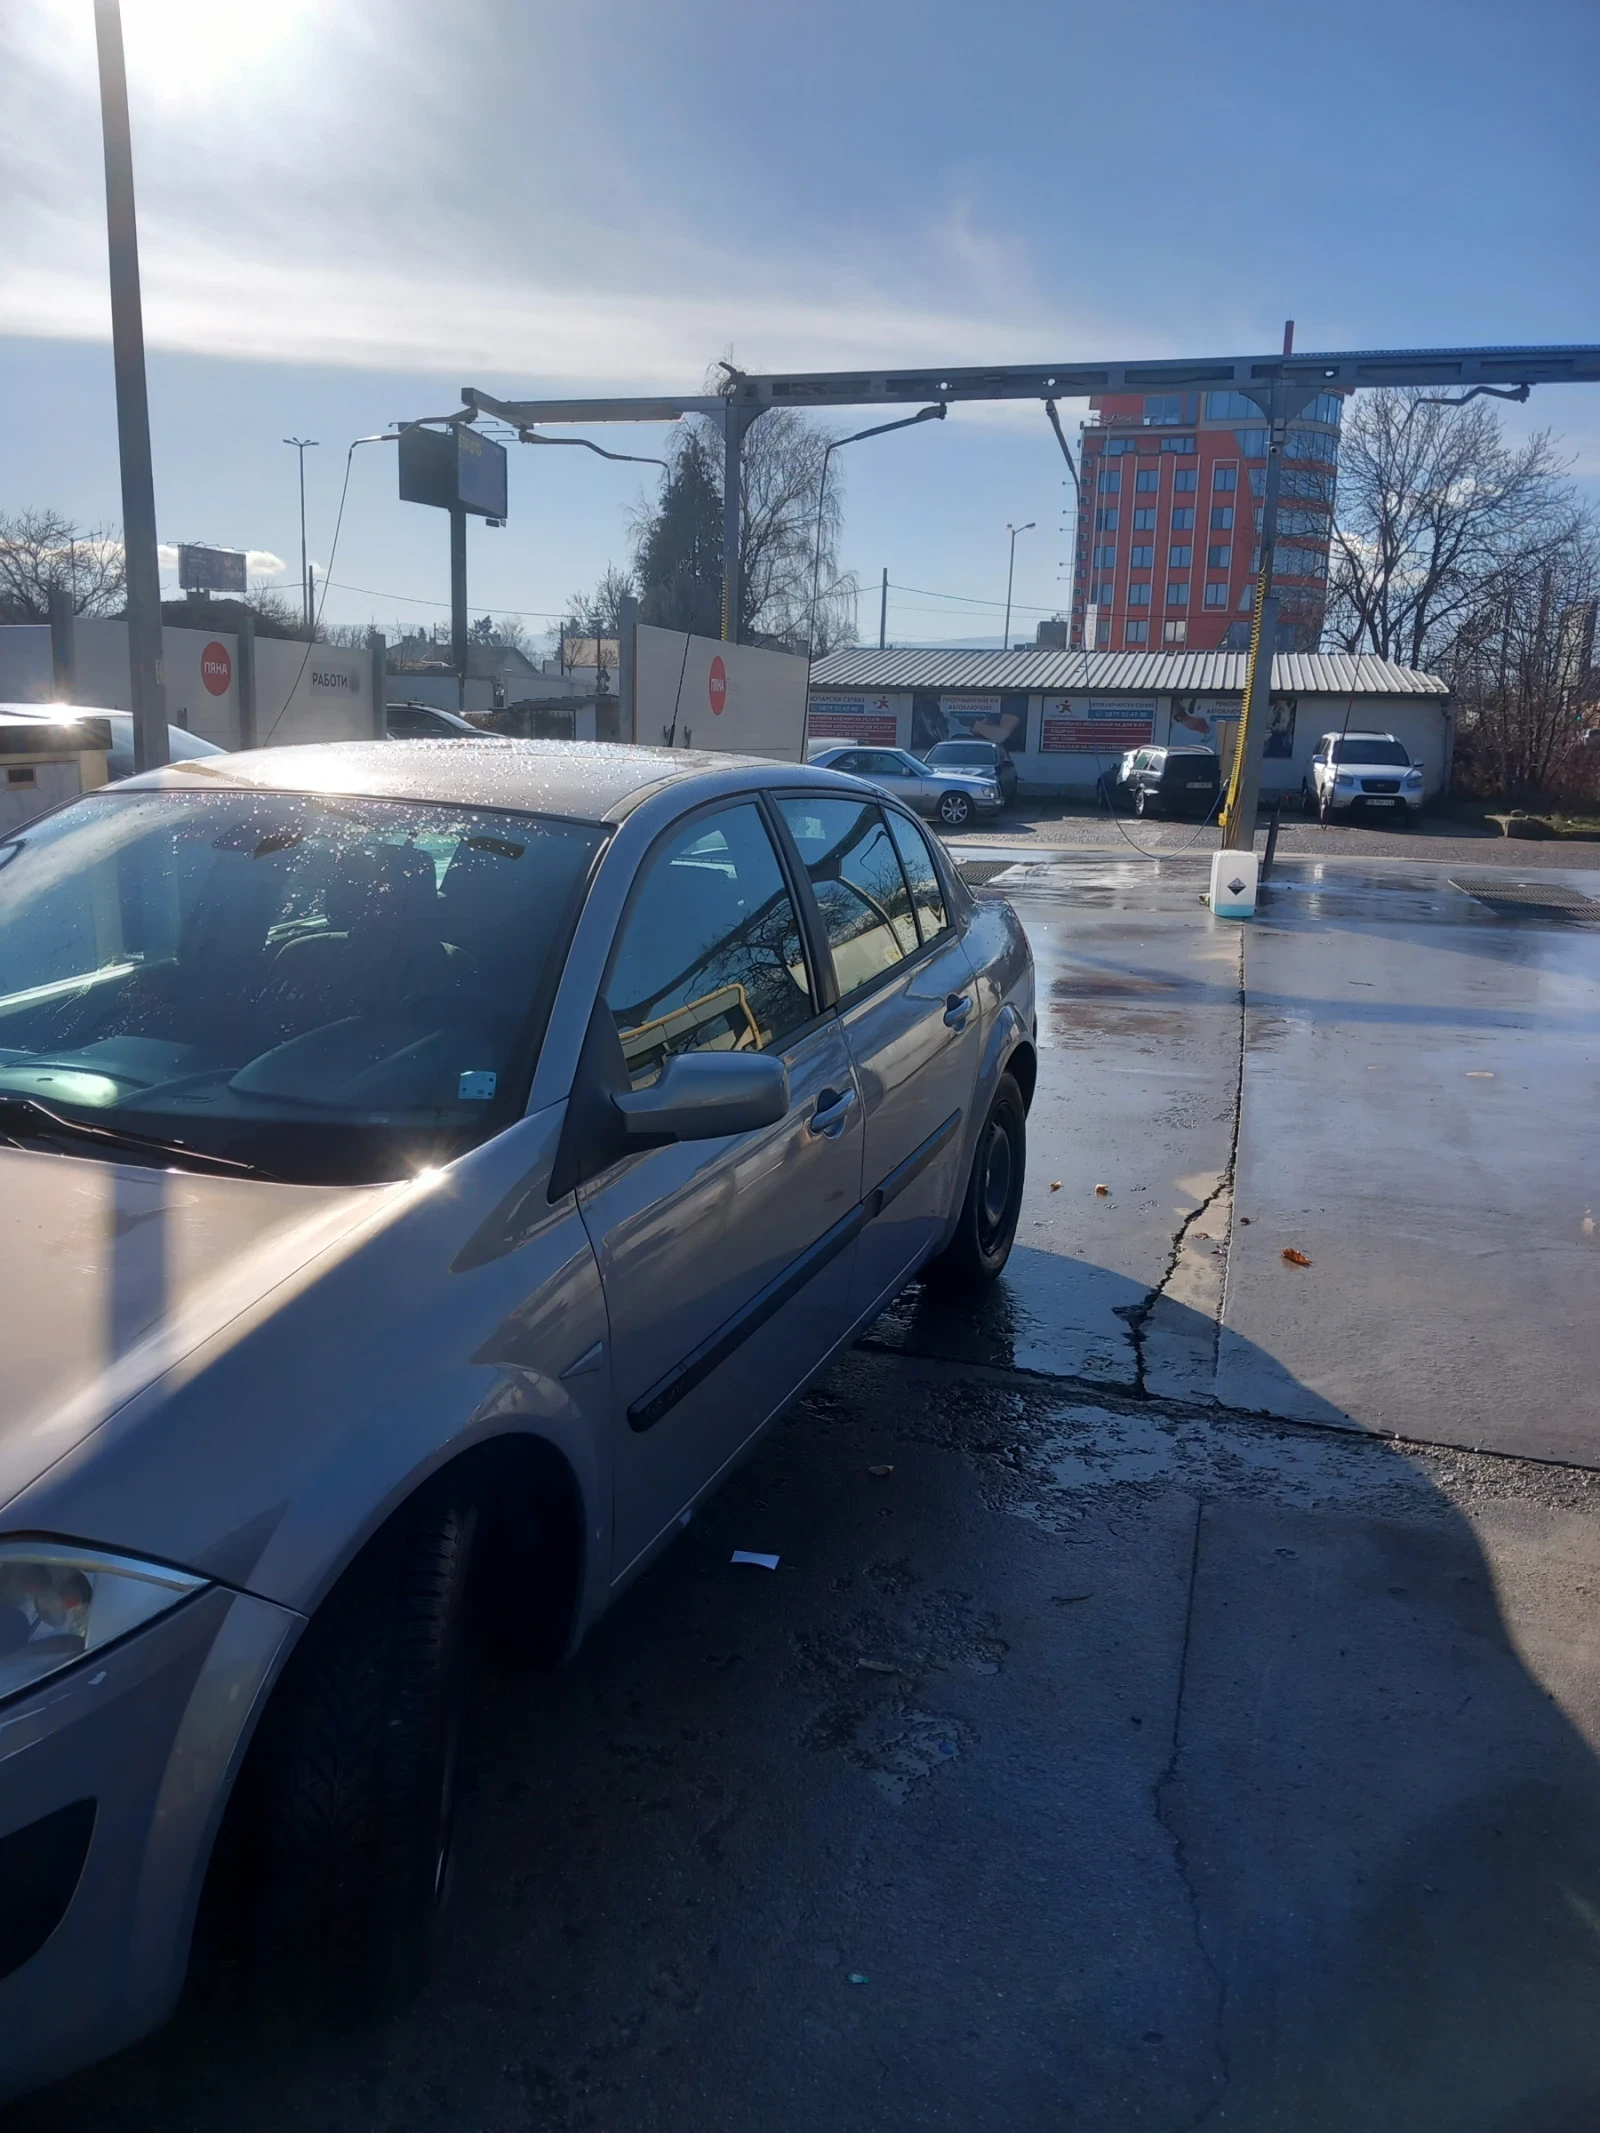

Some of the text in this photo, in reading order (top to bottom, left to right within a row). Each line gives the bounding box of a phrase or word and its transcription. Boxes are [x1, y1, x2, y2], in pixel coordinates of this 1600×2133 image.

[204, 661, 228, 675] ПЯНА
[312, 672, 348, 688] РАБОТИ
[710, 678, 725, 692] ПЯНА
